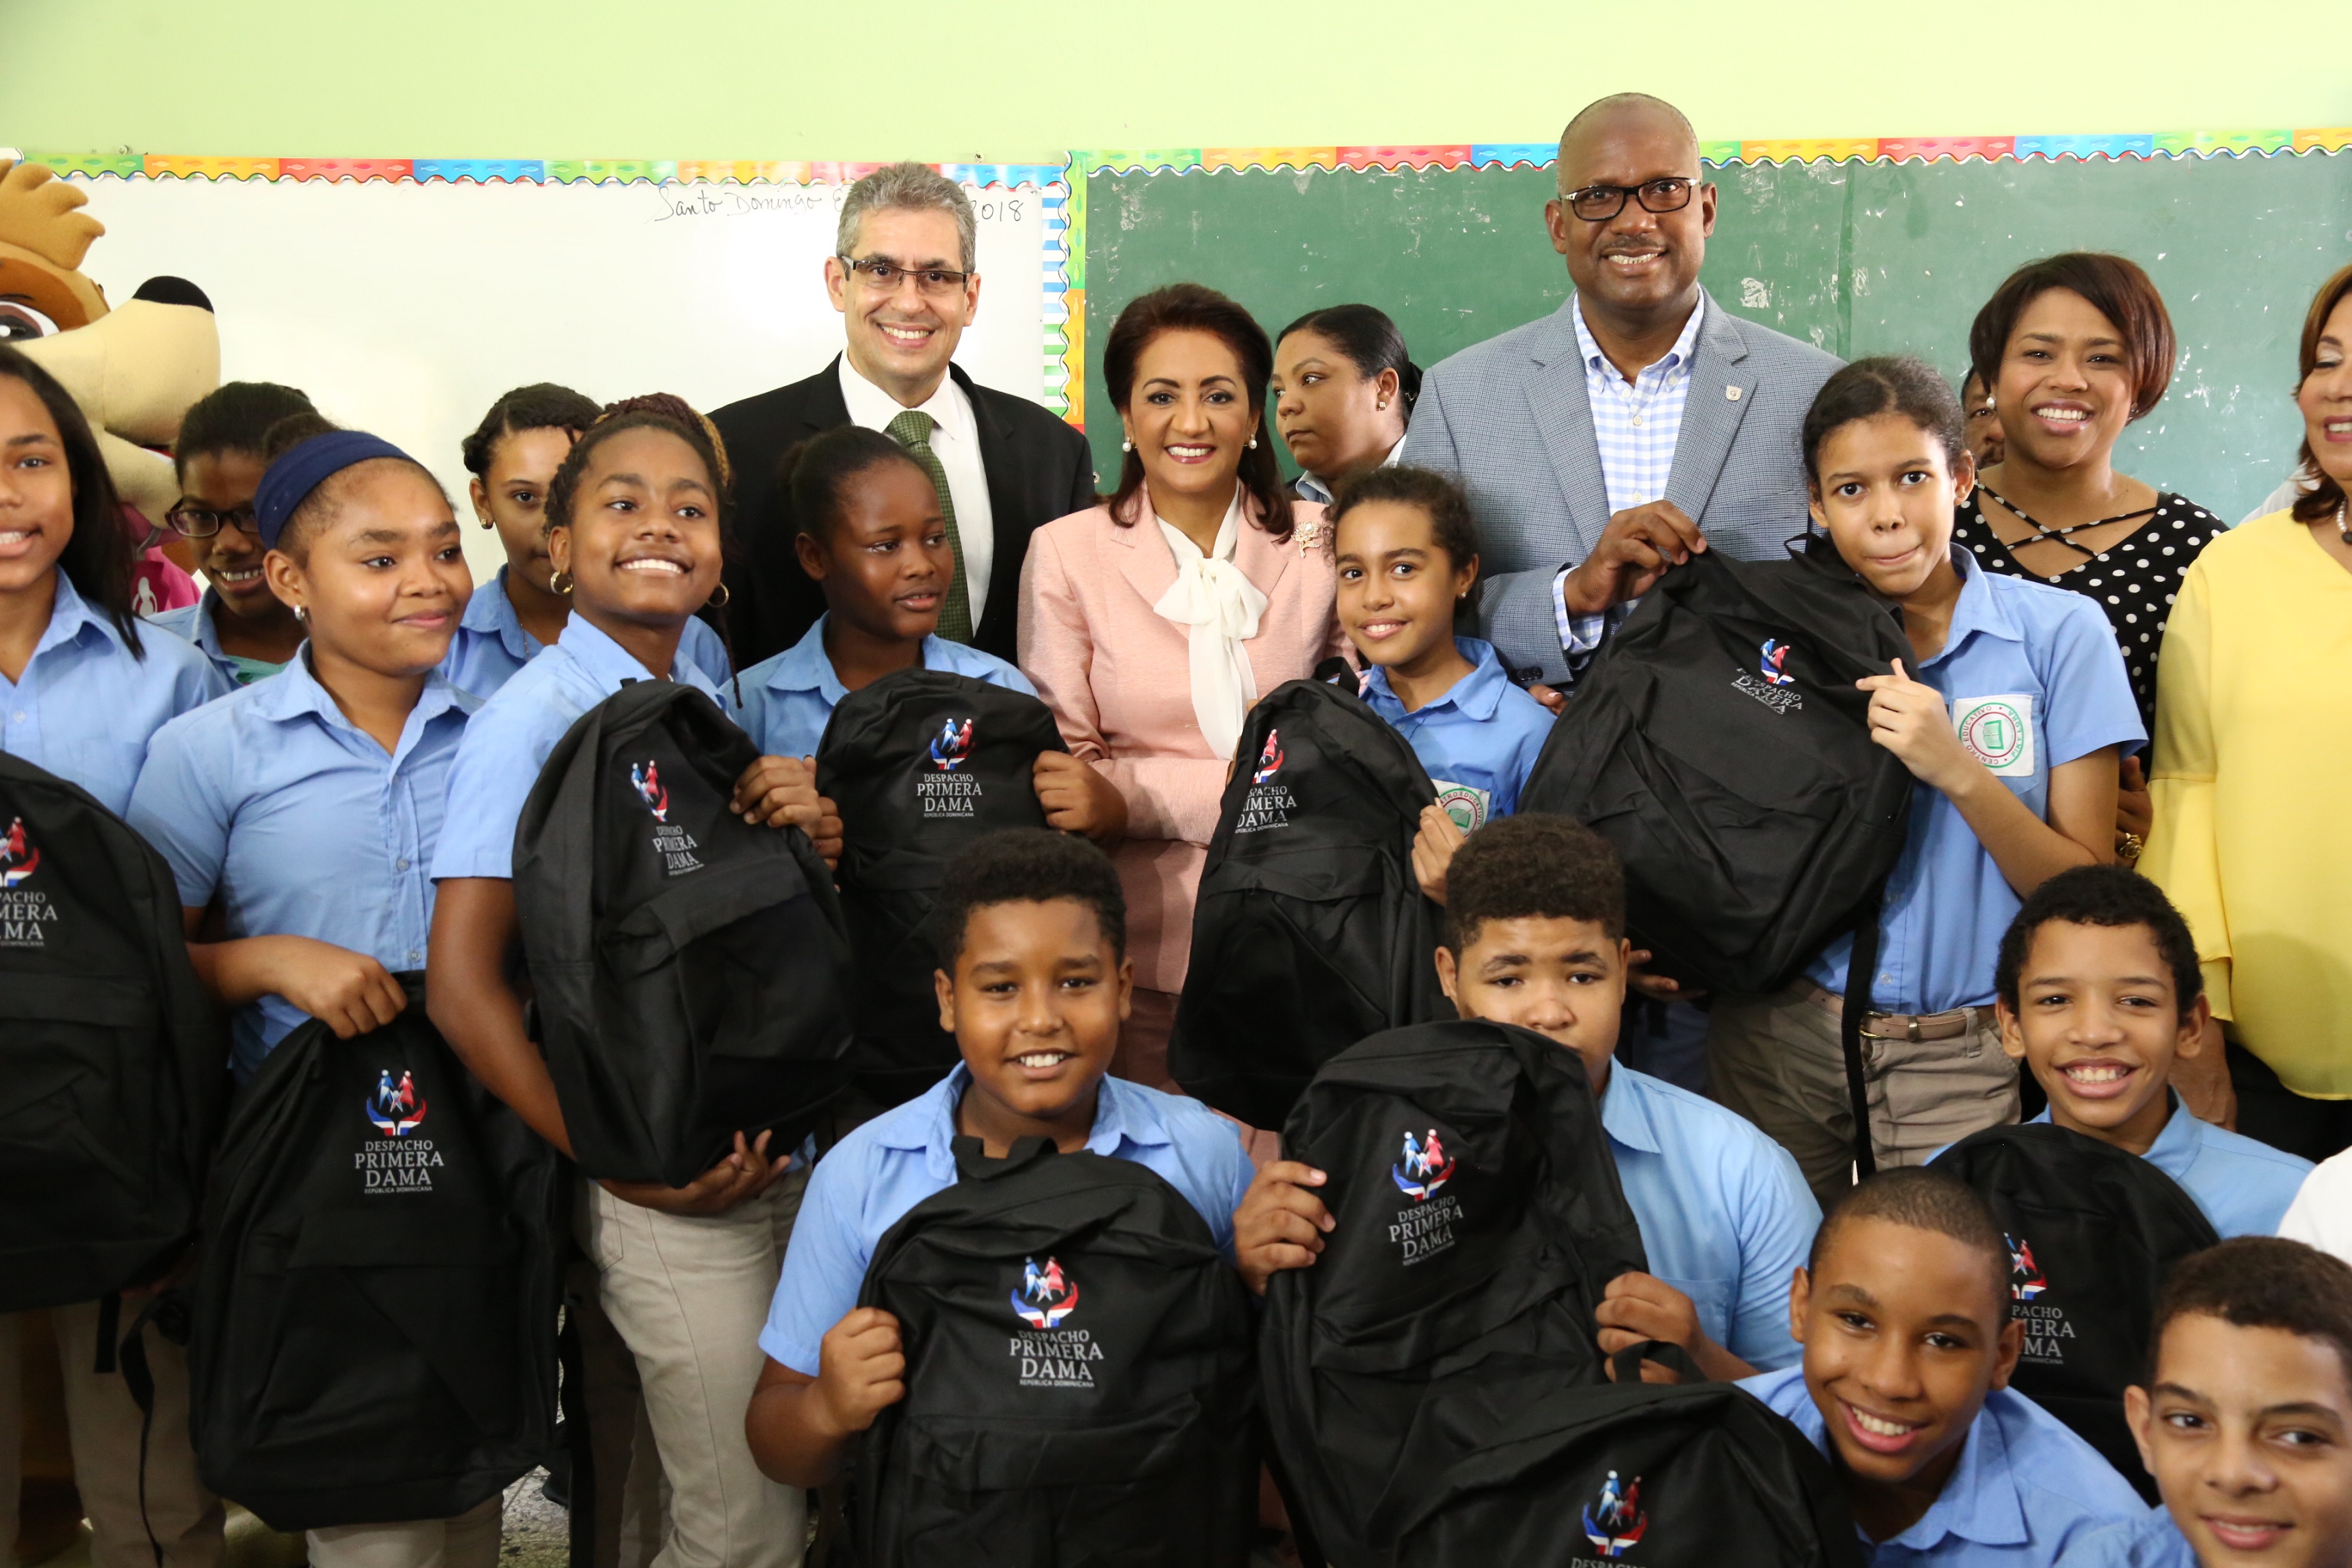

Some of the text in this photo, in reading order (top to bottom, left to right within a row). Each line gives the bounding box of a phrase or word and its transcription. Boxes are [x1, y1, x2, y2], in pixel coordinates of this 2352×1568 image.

[652, 186, 723, 222] Santo
[724, 190, 821, 216] Domingo
[1962, 706, 1992, 742] EDUCATIVO
[2008, 710, 2021, 733] LORA
[924, 773, 974, 783] DESPACHO
[917, 783, 983, 796] PRIMERA
[1247, 786, 1288, 798] SPACHO
[924, 797, 974, 812] DAMA
[1242, 796, 1298, 812] IMERA
[1237, 810, 1288, 828] DAMA
[666, 851, 699, 870] DAMA
[365, 1140, 433, 1152] DESPACHO
[355, 1151, 444, 1169] PRIMERA
[365, 1168, 432, 1188] DAMA
[1398, 1196, 1456, 1223] DESPACHO
[1388, 1205, 1464, 1243] PRIMERA
[1402, 1224, 1453, 1259] DAMA
[2012, 1305, 2062, 1319] PACHO
[1018, 1329, 1090, 1343] DESPACHO
[1009, 1338, 1104, 1360] PRIMERA
[1021, 1358, 1094, 1380] DAMA
